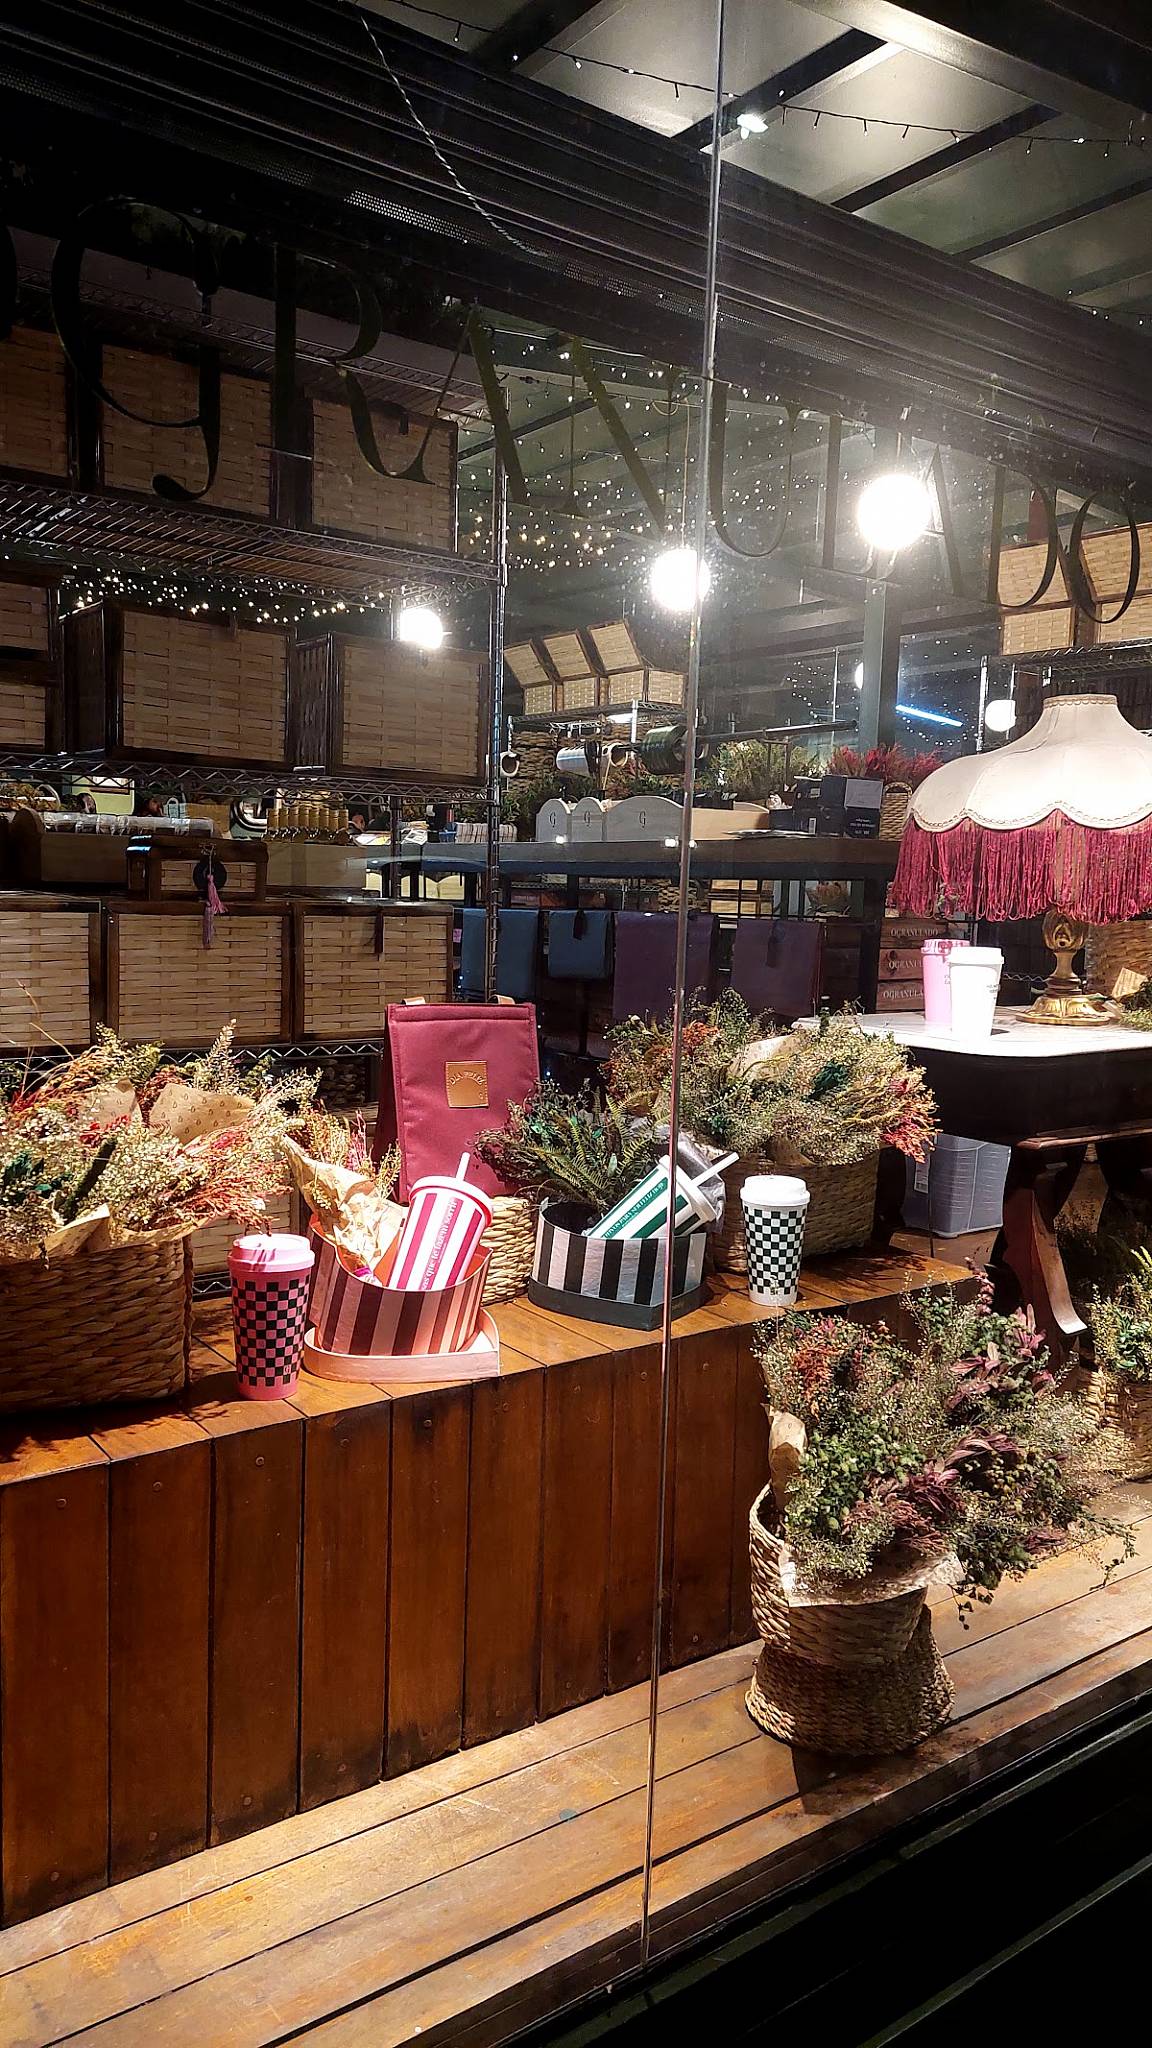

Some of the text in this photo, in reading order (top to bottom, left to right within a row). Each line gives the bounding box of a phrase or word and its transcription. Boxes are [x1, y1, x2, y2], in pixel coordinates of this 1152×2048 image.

[0, 194, 1140, 624] GRANULADO
[549, 811, 556, 828] G
[583, 810, 591, 827] G
[639, 810, 646, 828] G
[890, 927, 939, 938] OGRANULADO
